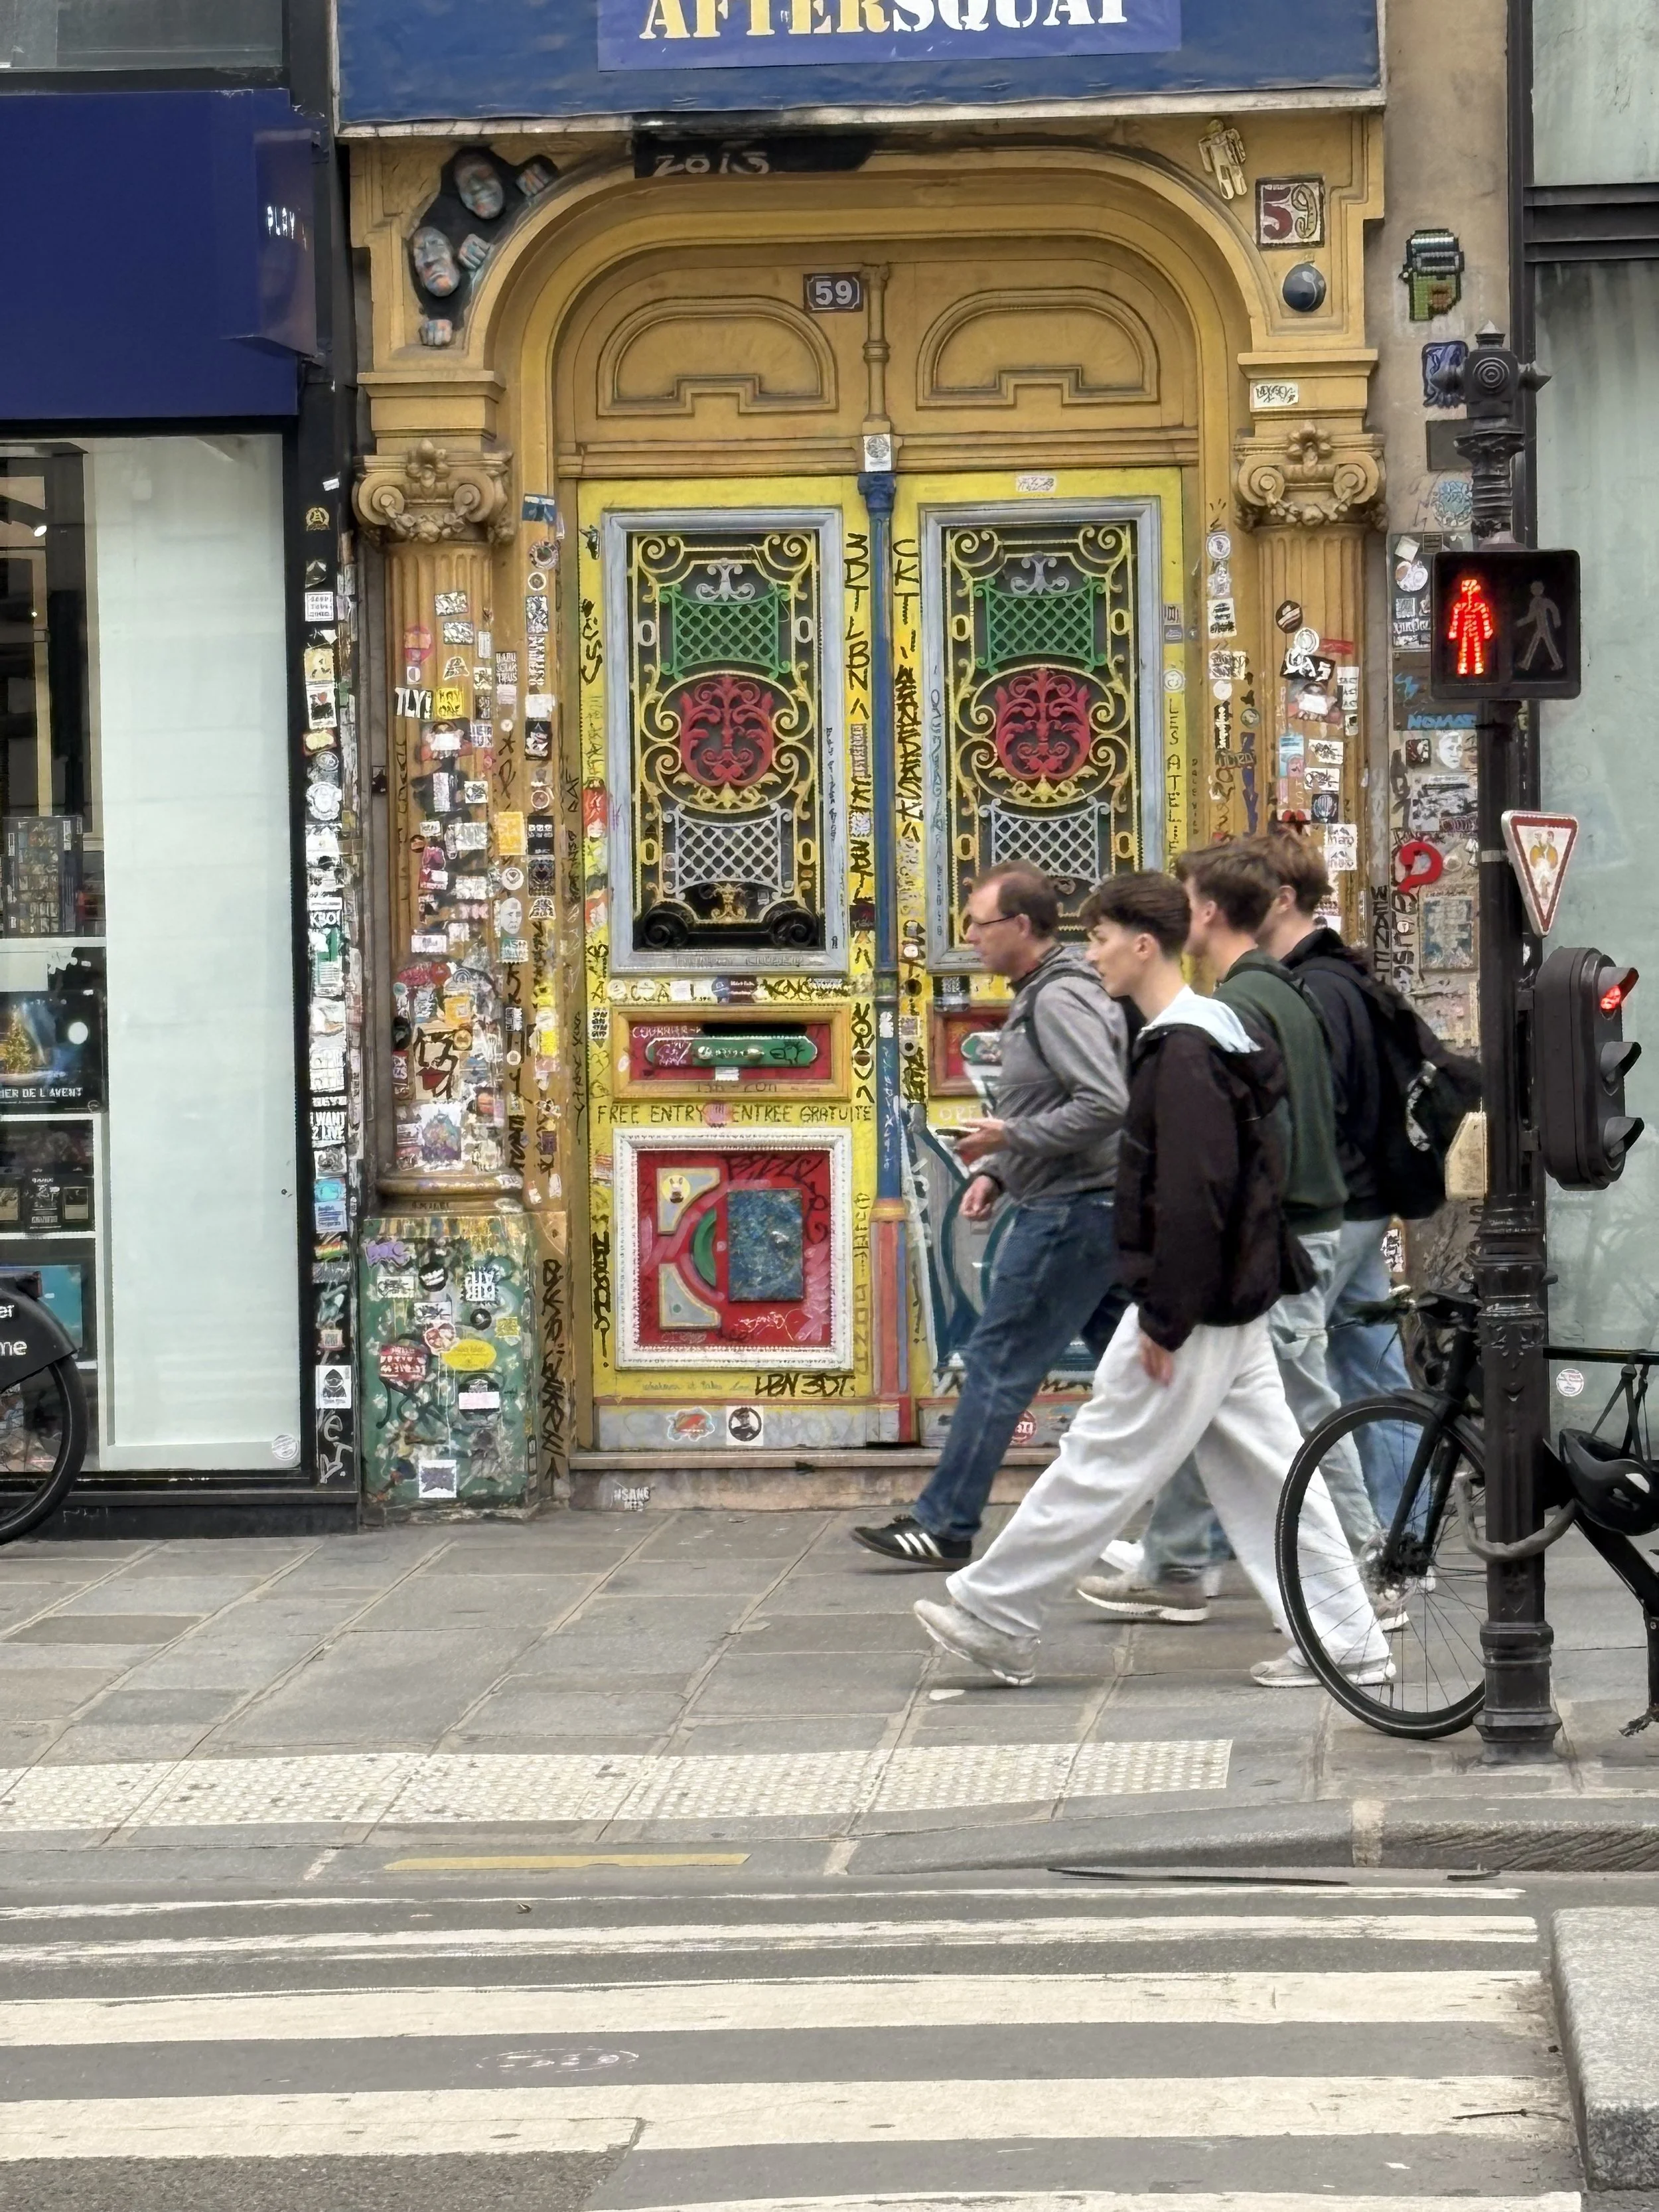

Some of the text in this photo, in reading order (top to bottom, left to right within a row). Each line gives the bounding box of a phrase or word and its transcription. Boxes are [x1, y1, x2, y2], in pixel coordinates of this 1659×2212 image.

[814, 279, 855, 307] 59
[597, 1105, 640, 1124] FREE
[799, 1104, 872, 1123] GRATUITE
